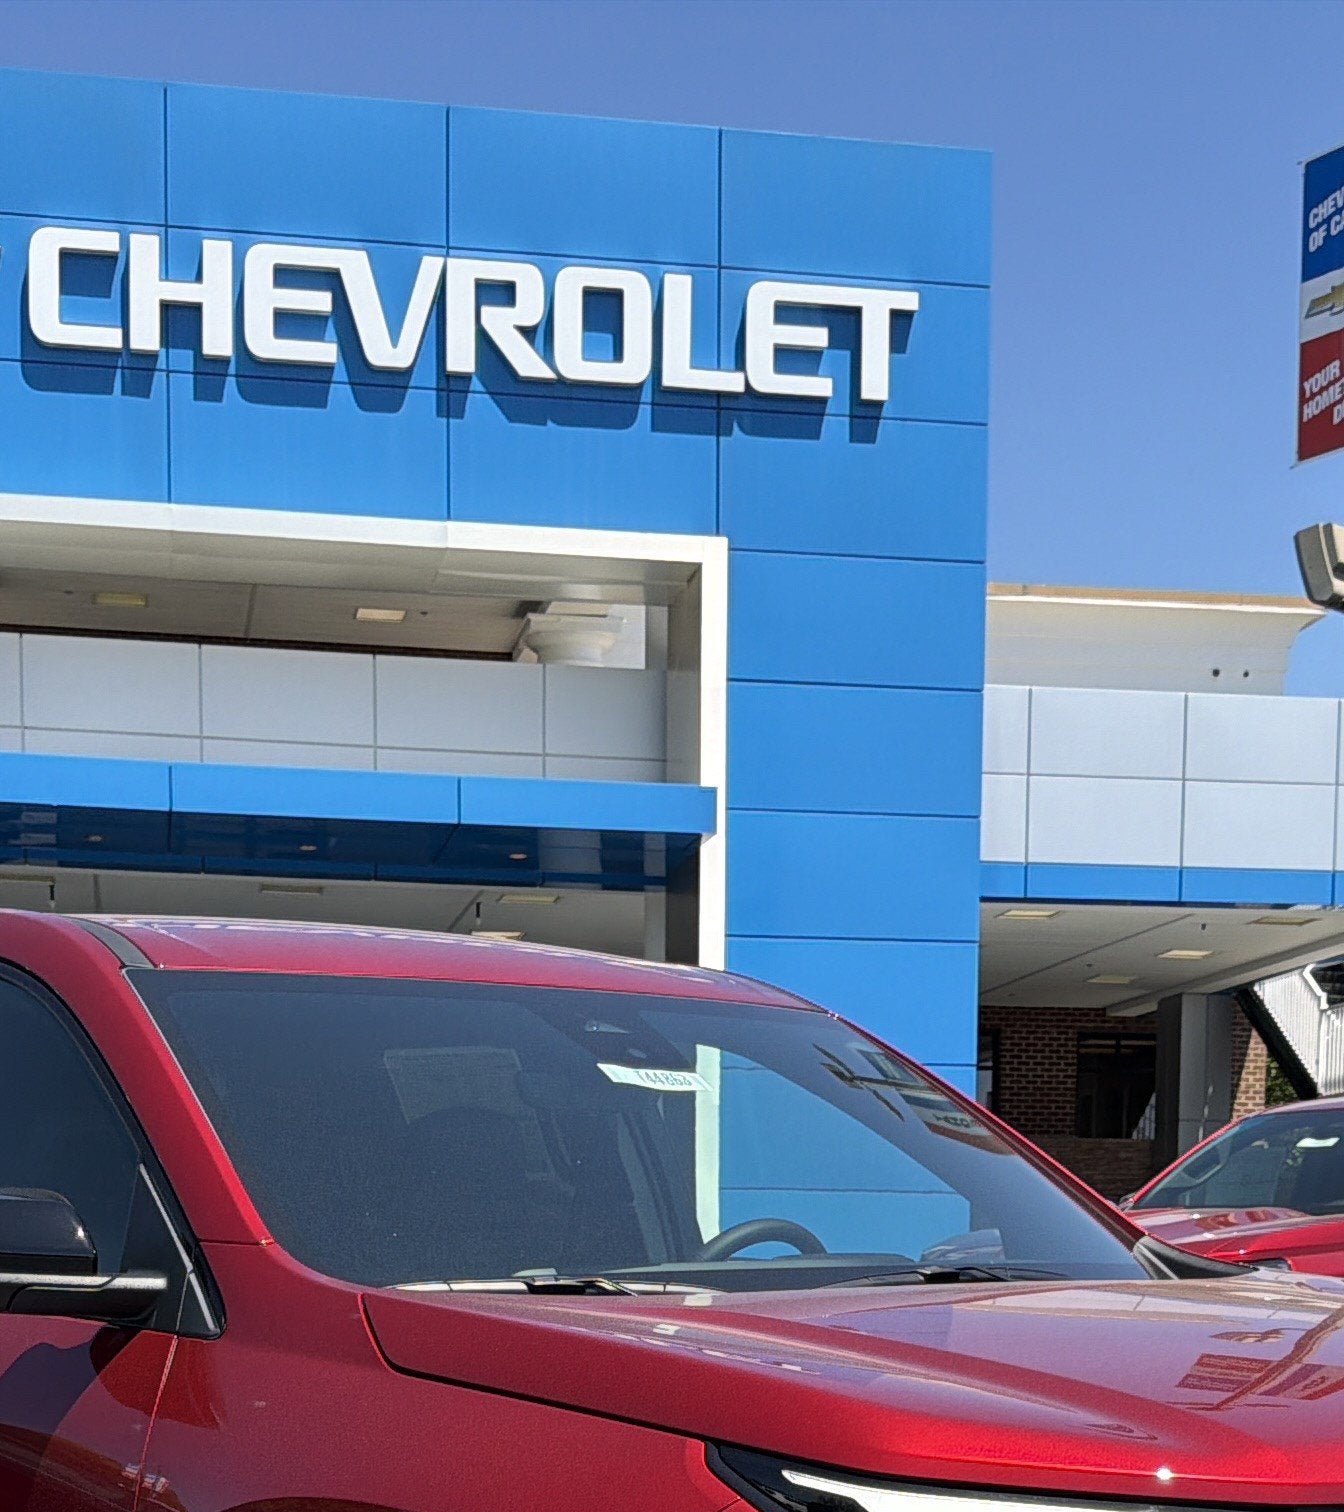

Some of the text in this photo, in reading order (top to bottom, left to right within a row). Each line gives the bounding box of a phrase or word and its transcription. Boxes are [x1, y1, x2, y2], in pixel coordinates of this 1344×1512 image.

[1308, 223, 1328, 253] OF
[27, 227, 920, 403] CHEVROLET
[1303, 359, 1341, 398] YOUR
